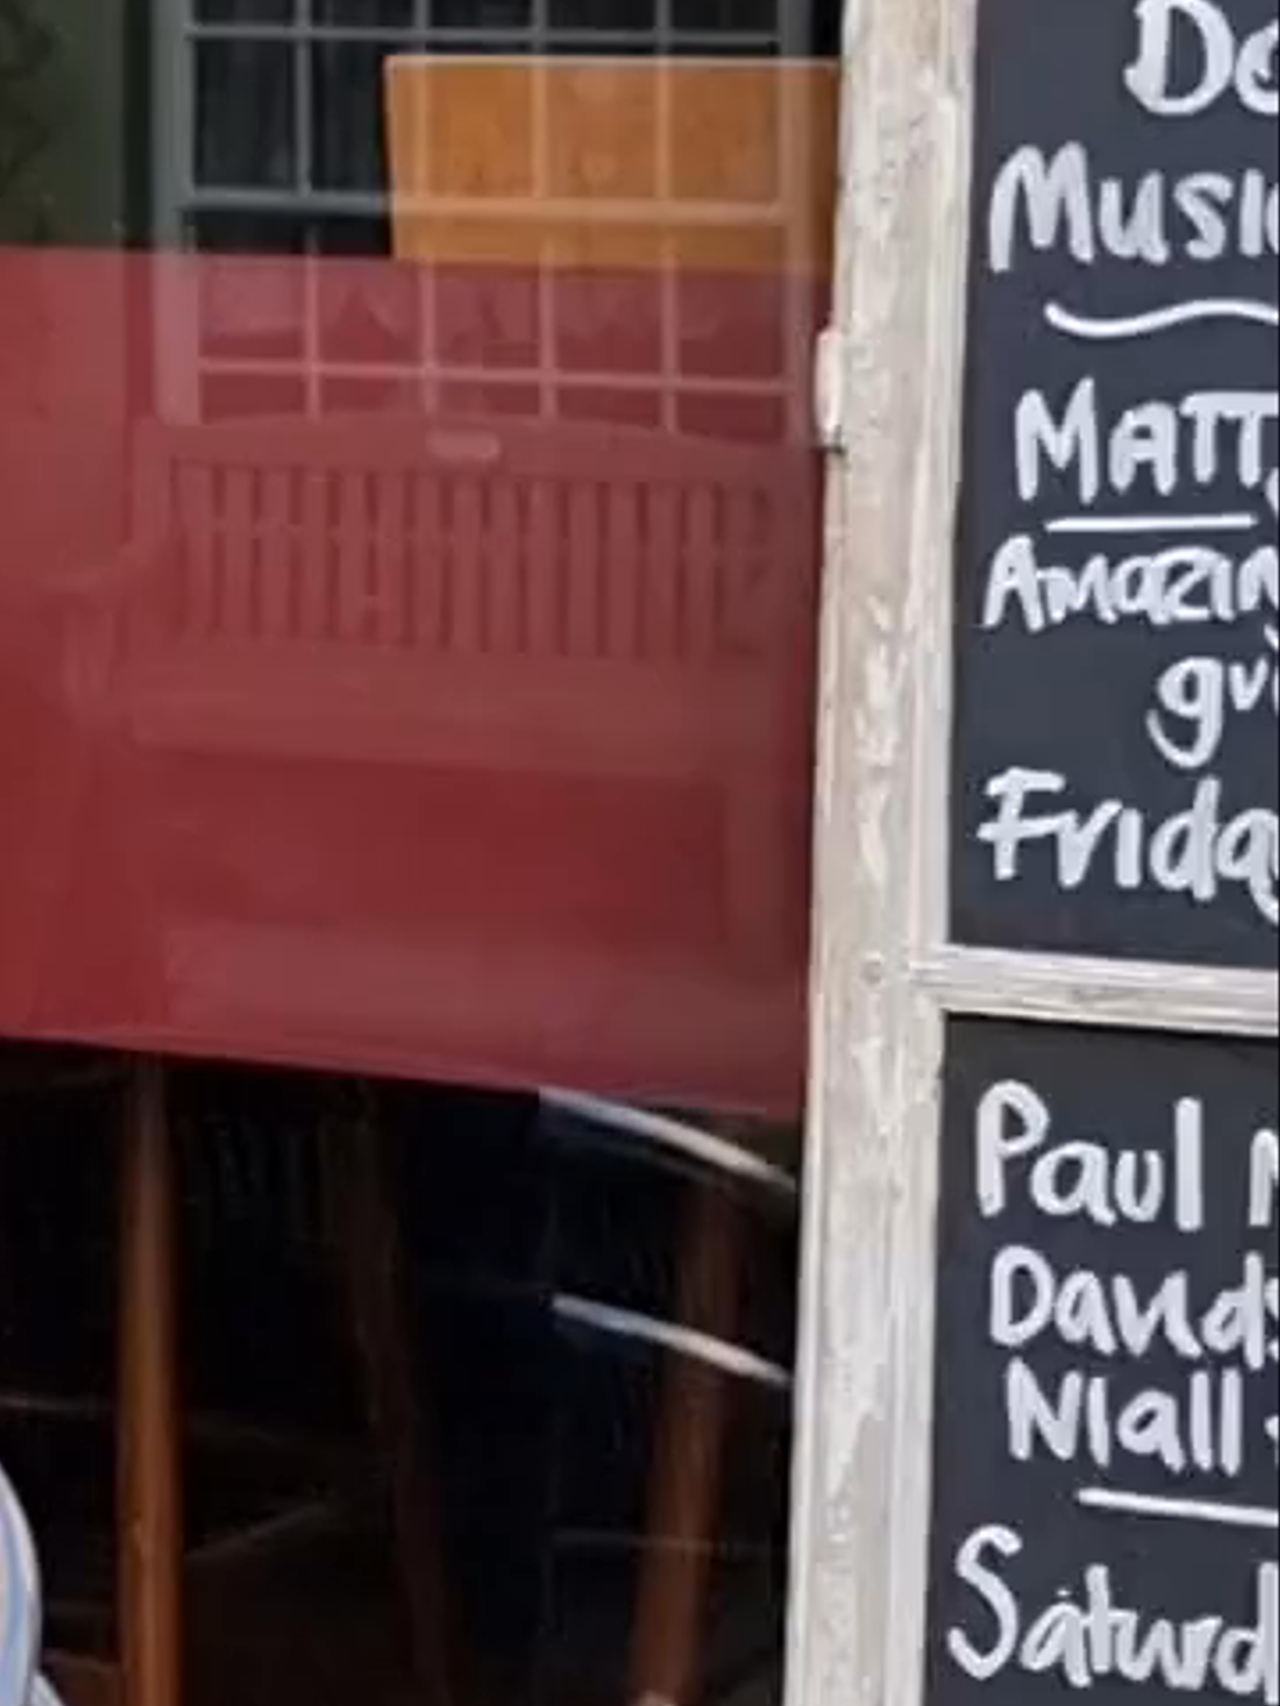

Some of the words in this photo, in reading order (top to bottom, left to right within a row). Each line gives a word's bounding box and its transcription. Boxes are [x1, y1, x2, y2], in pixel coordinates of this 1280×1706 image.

[975, 1078, 1203, 1232] Paul
[1005, 1356, 1243, 1477] Niall
[946, 1523, 1279, 1706] Saturd
